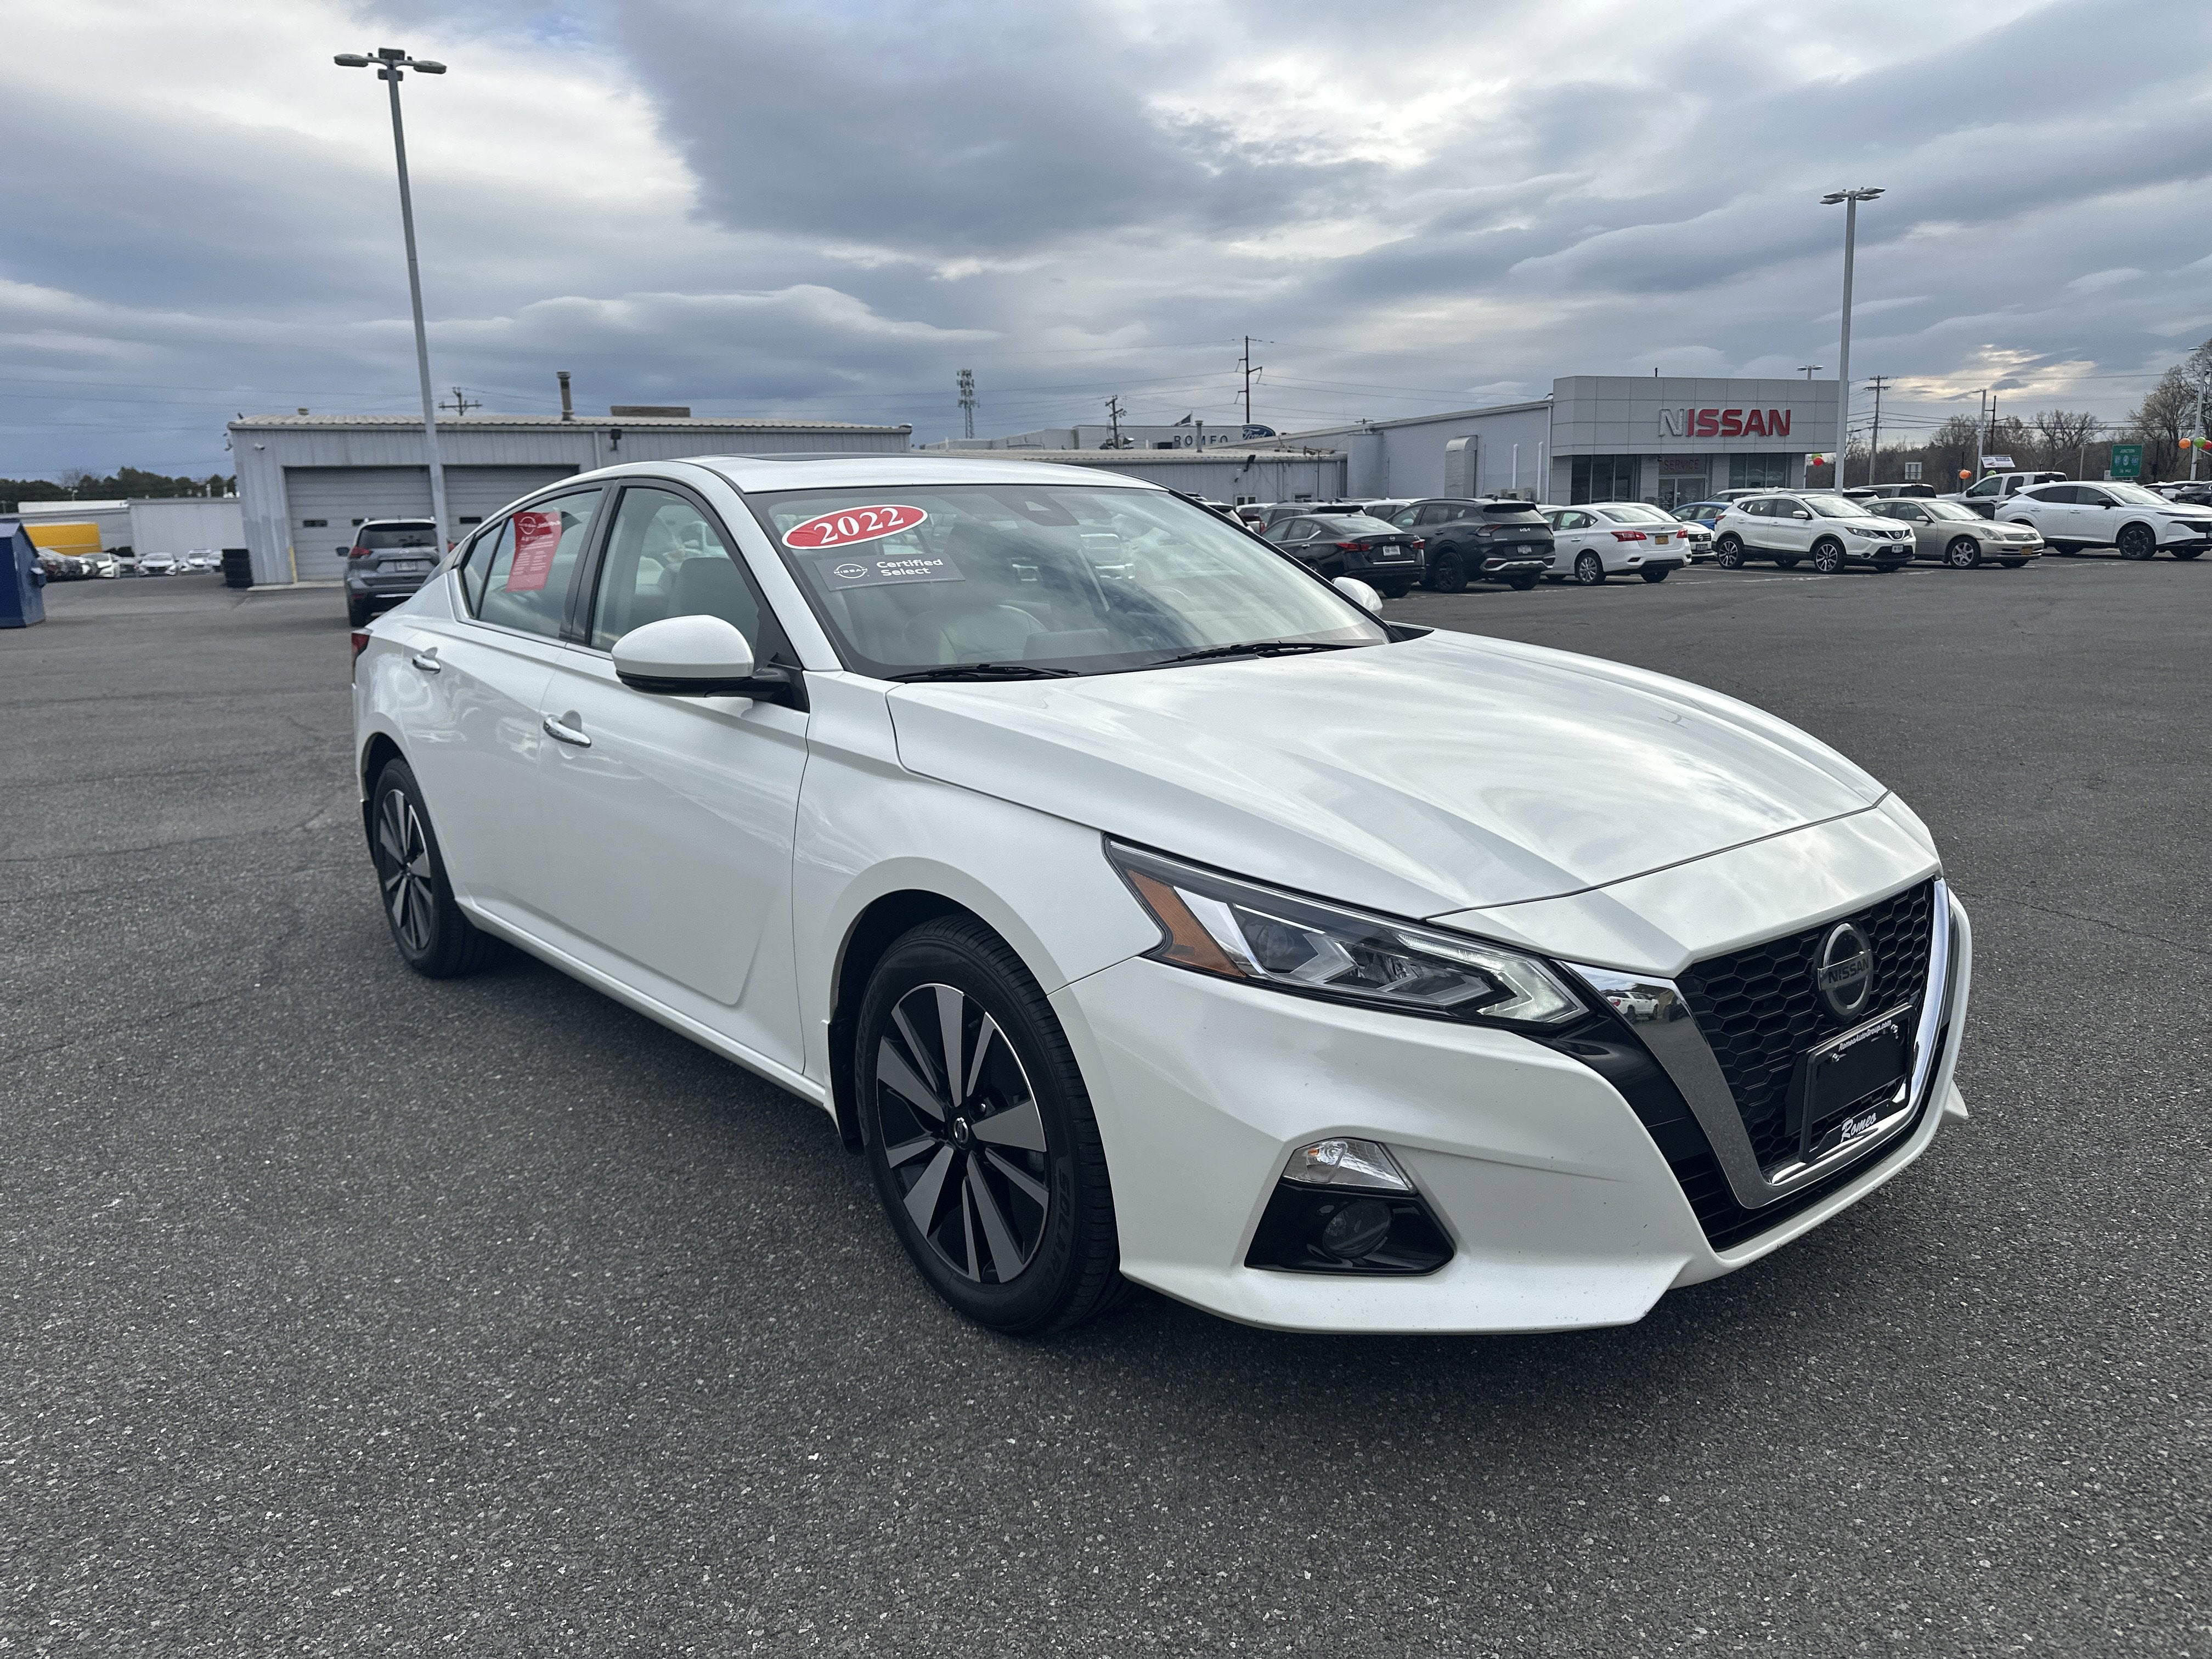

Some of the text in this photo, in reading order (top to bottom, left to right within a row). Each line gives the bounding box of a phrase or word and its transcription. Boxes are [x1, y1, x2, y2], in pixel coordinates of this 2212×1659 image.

[1658, 409, 1791, 437] NISSAN
[1243, 428, 1266, 439] Ford
[1663, 459, 1699, 470] SERVICE
[814, 507, 904, 544] 2022
[876, 558, 943, 569] Certified
[880, 568, 931, 577] Select
[1829, 956, 1869, 984] NISSAN
[1840, 1113, 1876, 1143] Romeo
